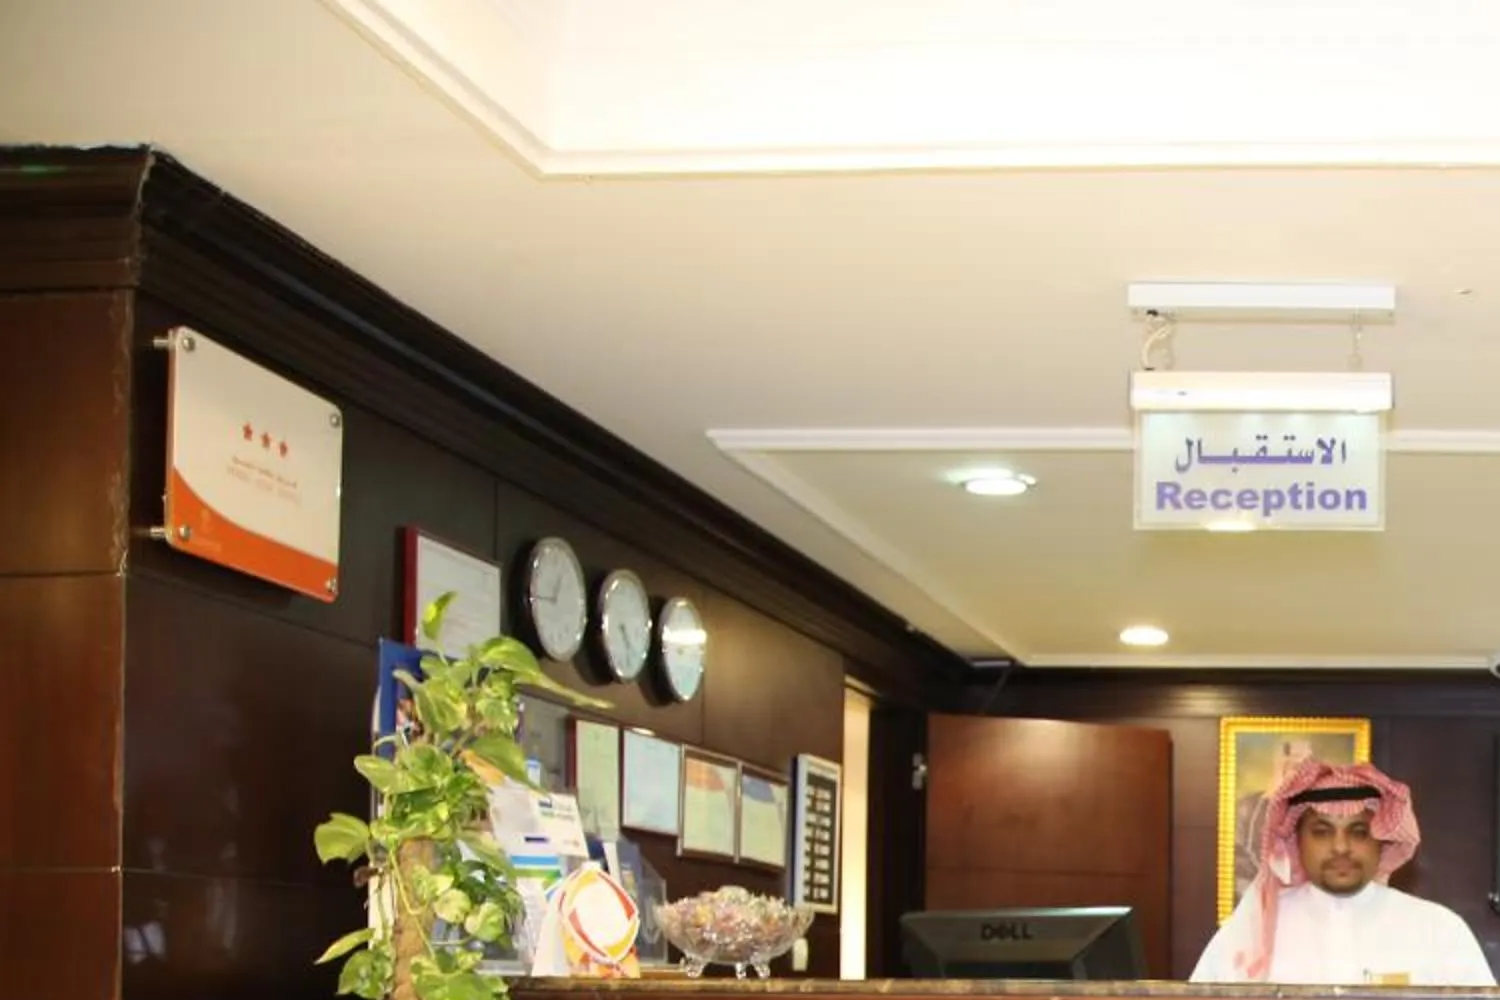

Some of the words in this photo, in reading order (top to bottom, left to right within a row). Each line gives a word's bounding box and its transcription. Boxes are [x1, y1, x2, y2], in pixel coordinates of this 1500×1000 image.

[1174, 433, 1347, 474] الاستقبال
[1155, 480, 1368, 517] Reception
[980, 923, 1032, 941] DELL
